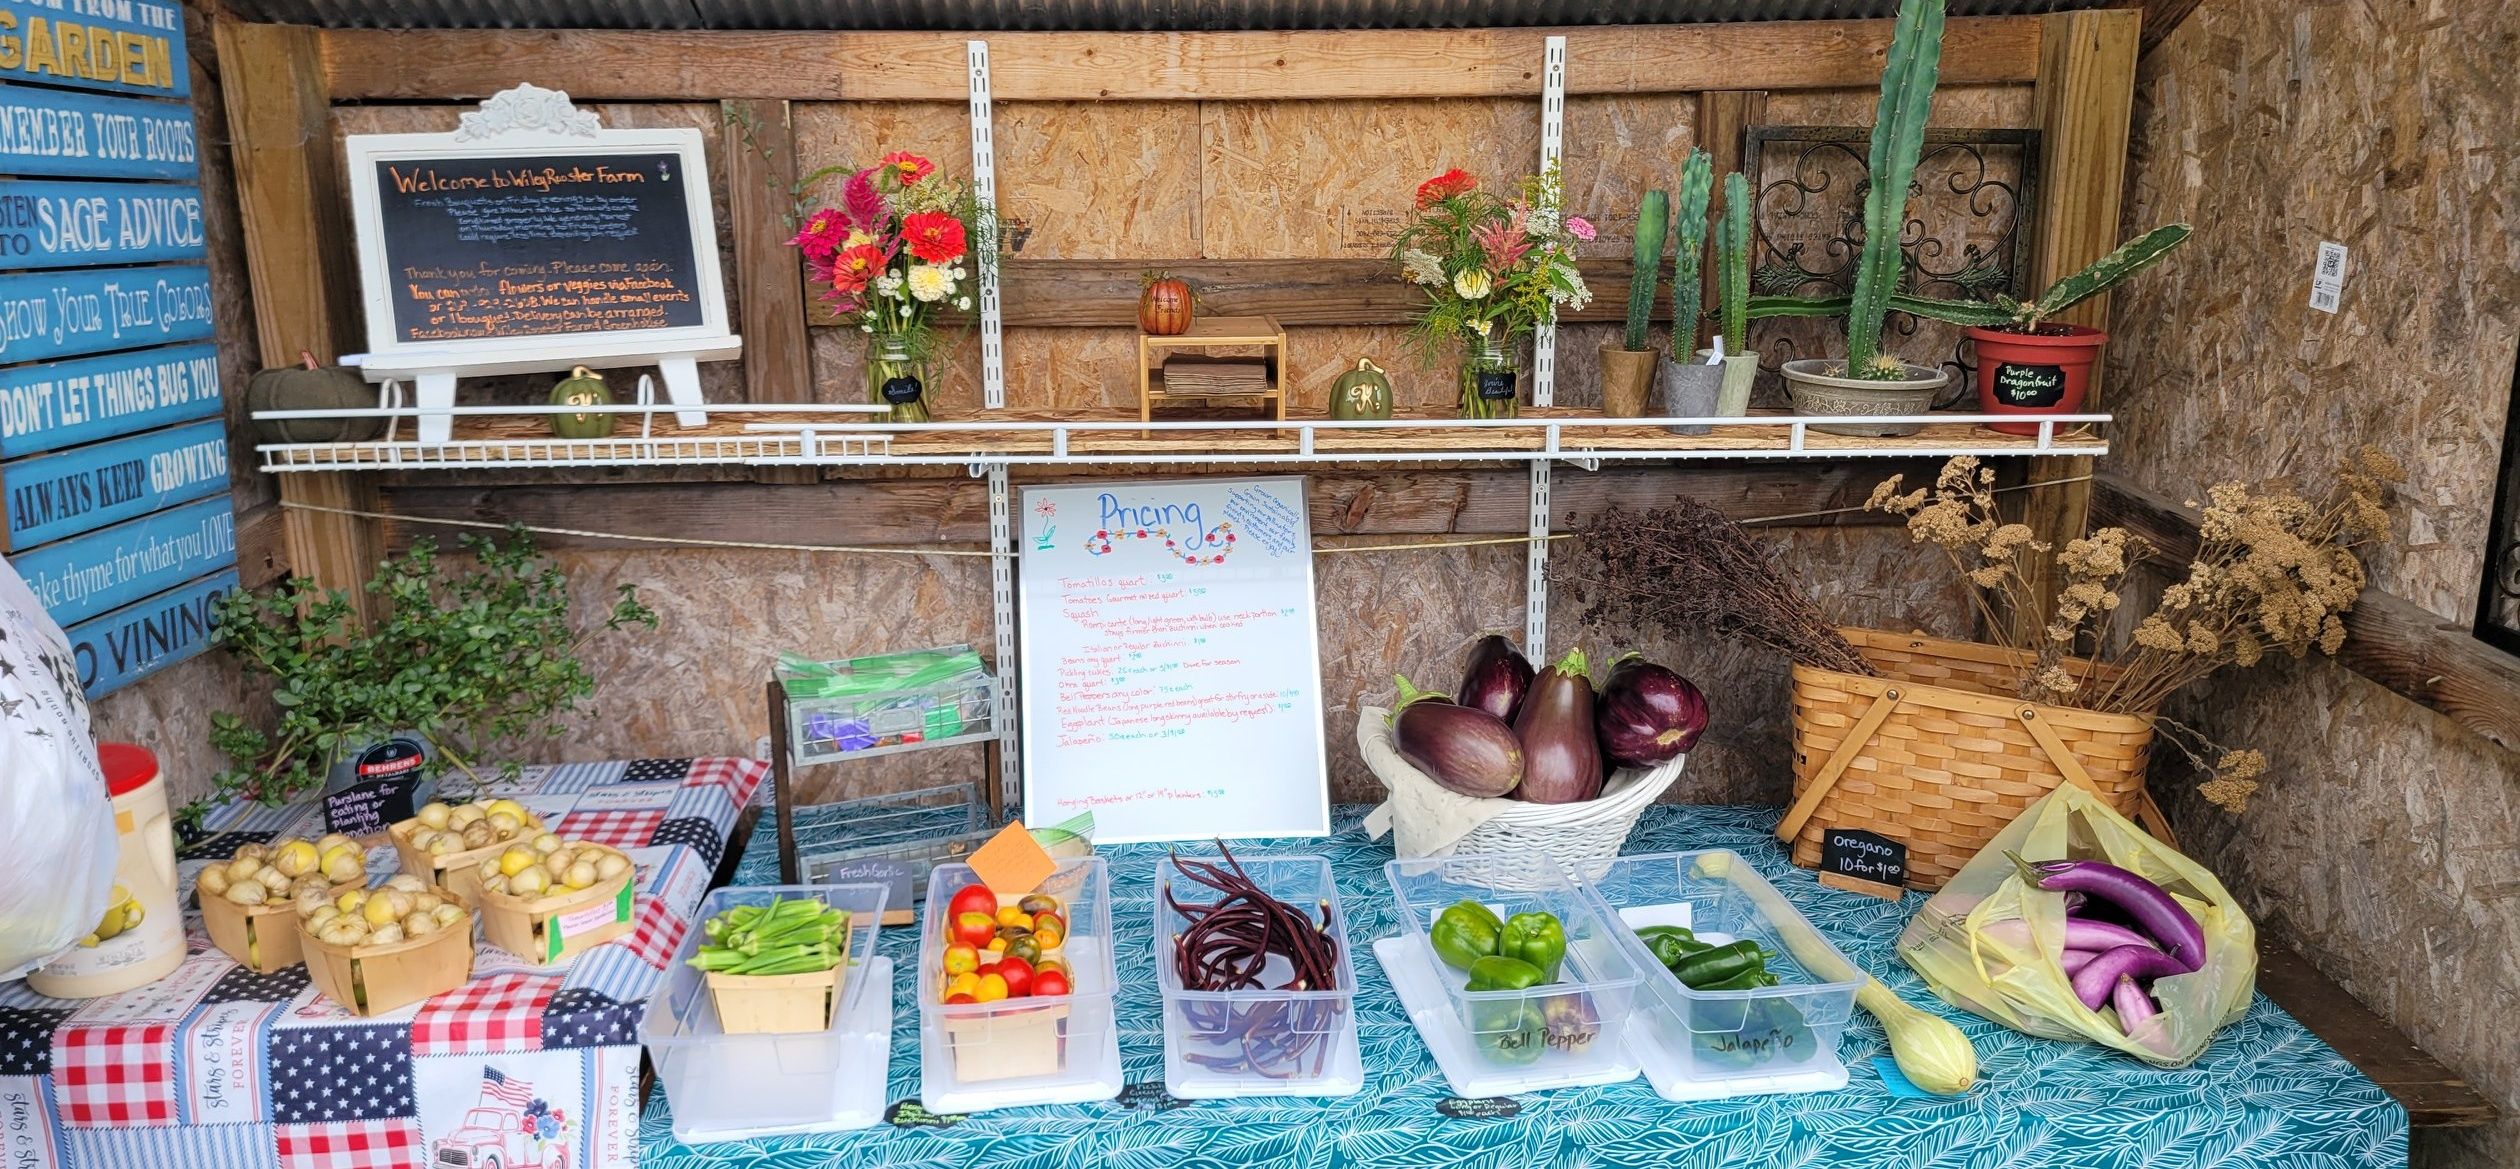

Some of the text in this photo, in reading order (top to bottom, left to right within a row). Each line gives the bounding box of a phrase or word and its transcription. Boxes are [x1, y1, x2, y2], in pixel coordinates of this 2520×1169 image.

[138, 3, 177, 31] THE
[0, 10, 174, 89] GARDEN
[93, 113, 141, 160] YOUR
[143, 118, 195, 163] ROOTS
[389, 166, 490, 193] Welcome
[491, 168, 510, 188] to
[595, 166, 645, 183] Farm
[38, 198, 204, 253] SAGE ADVICE
[403, 266, 446, 280] Thank
[448, 268, 477, 286] you
[479, 261, 499, 277] for
[551, 261, 597, 273] Please
[599, 262, 631, 273] come
[409, 283, 434, 300] You
[498, 279, 545, 295] flowers
[545, 282, 562, 292] or
[563, 279, 607, 294] veggies
[608, 279, 626, 290] via
[622, 276, 675, 290] Facebook
[619, 291, 652, 304] small
[1151, 295, 1178, 303] Welcome
[53, 287, 103, 345] YOUR
[104, 282, 153, 338] TRUE
[156, 279, 213, 333] COLORS
[430, 315, 446, 325] or
[562, 310, 586, 320] can
[585, 306, 604, 319] be
[2000, 375, 2057, 390] Dragonfruit
[2006, 366, 2034, 379] Purple
[0, 357, 219, 438] DON'T LET THINGS BUG YOU
[14, 438, 227, 532] ALWAYS KEEP GROWING
[1096, 493, 1203, 551] Pricing
[62, 561, 113, 606] thyme
[115, 547, 139, 583] for
[139, 537, 176, 571] what
[176, 532, 201, 563] you
[201, 512, 235, 561] LOVE
[1058, 576, 1113, 590] Tomatillos
[1062, 608, 1099, 621] Squash
[1214, 657, 1241, 666] season
[1061, 715, 1105, 733] Eggplant
[366, 758, 417, 774] BEHRENS
[328, 783, 400, 808] Purslane for
[331, 799, 385, 818] eating or
[332, 810, 380, 829] planting
[1834, 835, 1893, 858] Oregano
[839, 862, 905, 879] Fresh Garlic
[1840, 857, 1874, 874] 10 for
[1498, 1026, 1596, 1051] Bell Pepper
[607, 1085, 619, 1162] FOREVER
